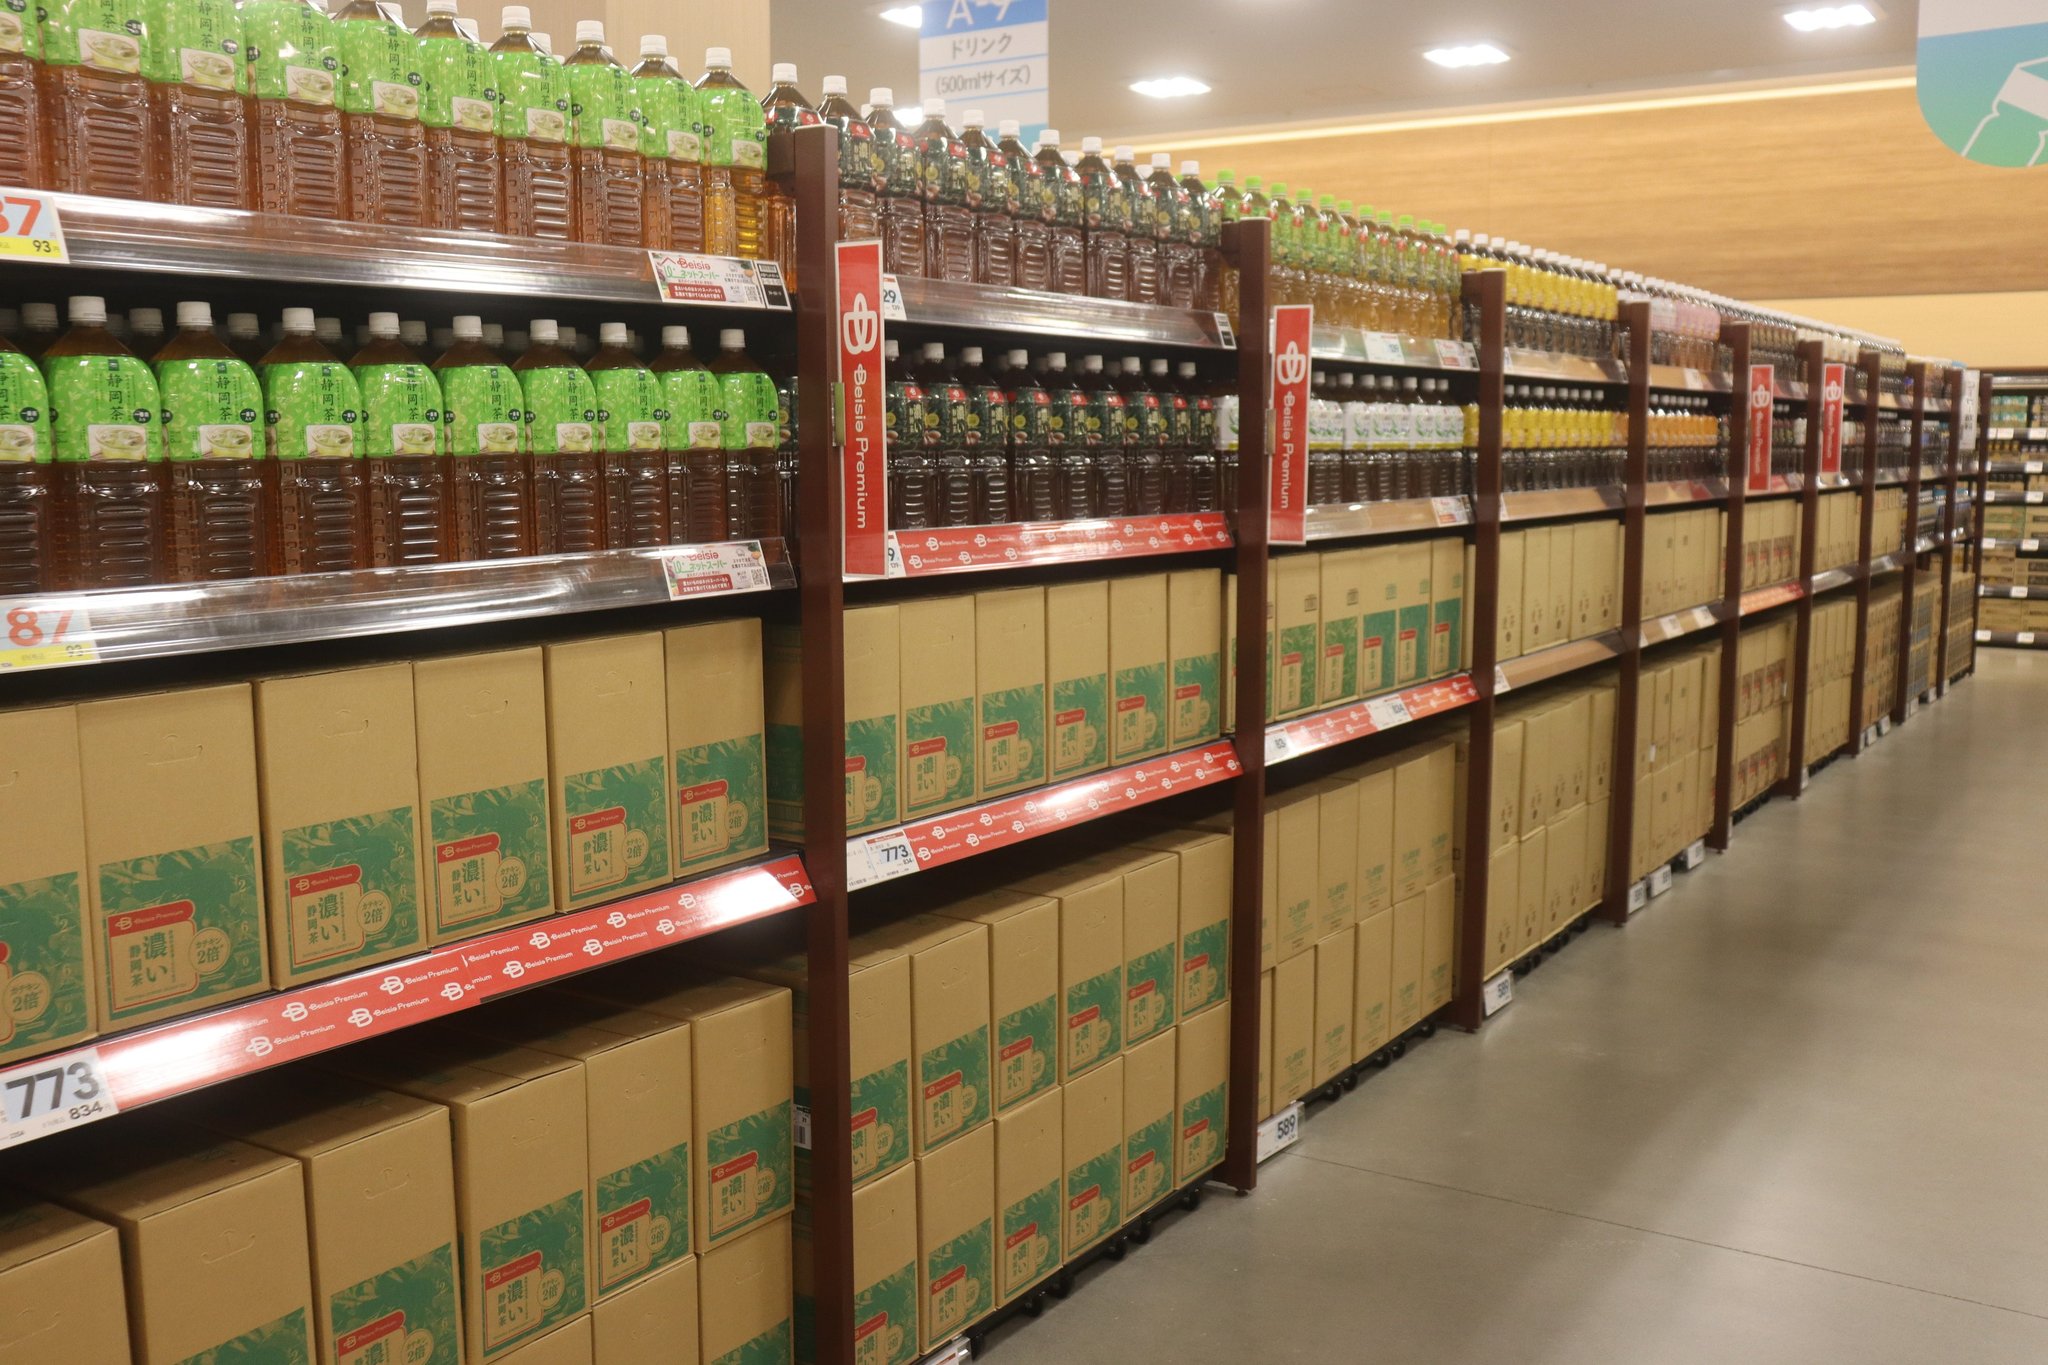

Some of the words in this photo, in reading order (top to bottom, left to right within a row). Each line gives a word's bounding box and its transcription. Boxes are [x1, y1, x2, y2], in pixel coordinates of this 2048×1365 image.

[301, 20, 316, 65] 静岡茶
[952, 33, 1012, 60] ドリンク
[388, 39, 401, 81] 静岡茶
[466, 55, 477, 95] 静岡茶
[935, 64, 1031, 95] (500mlサイズ)
[0, 196, 42, 236] 7
[33, 240, 51, 253] 93
[677, 257, 711, 270] Beisia
[106, 374, 125, 422] 静岡茶
[215, 376, 233, 422] 静岡茶
[320, 378, 335, 421] 静岡茶
[406, 379, 419, 421] 静岡茶
[490, 380, 502, 421] 静岡茶
[567, 382, 579, 420] 静岡茶
[637, 382, 648, 420] 静岡茶
[853, 363, 868, 434] Beisia
[1282, 391, 1296, 441] Beisia
[855, 436, 869, 530] Premium
[1280, 442, 1295, 510] Premium
[7, 607, 74, 647] 87
[699, 801, 713, 841] 濃い
[729, 814, 743, 829] 2倍
[592, 831, 608, 873] 濃い
[627, 845, 642, 860] 2倍
[881, 844, 909, 862] 773
[461, 859, 481, 904] 濃い
[500, 865, 520, 876] カテキン
[501, 874, 520, 889] 2倍
[451, 867, 462, 907] 静岡茶
[318, 893, 339, 940] 濃い
[361, 900, 384, 911] カテキン
[363, 908, 385, 926] 2倍
[627, 911, 645, 920] Beisia
[645, 905, 670, 916] Premium
[306, 905, 318, 945] 静岡茶
[551, 930, 571, 940] Beisia
[572, 924, 598, 936] Premium
[603, 938, 622, 947] Beisia
[622, 931, 648, 942] Premium
[142, 931, 168, 983] 濃い
[195, 937, 223, 949] カテキン
[197, 947, 221, 966] 2倍
[468, 952, 490, 963] Beisia
[490, 944, 519, 957] Premium
[128, 944, 143, 988] 静岡茶
[405, 974, 427, 985] Beisia
[428, 965, 458, 979] Premium
[525, 959, 545, 969] Beisia
[546, 951, 573, 963] Premium
[13, 992, 38, 1013] 2倍
[309, 999, 334, 1011] Beisia
[335, 991, 368, 1006] Premium
[373, 1005, 396, 1017] Beisia
[397, 996, 429, 1011] Premium
[274, 1033, 299, 1045] Beisia
[300, 1023, 335, 1038] Premium
[5, 1062, 99, 1119] 773
[69, 1100, 104, 1119] 834
[1277, 1114, 1296, 1139] 589
[729, 1175, 742, 1213] 濃い
[757, 1181, 770, 1195] 2倍
[619, 1225, 635, 1264] 濃い
[651, 1232, 664, 1247] 2倍
[507, 1281, 523, 1320] 濃い
[542, 1286, 558, 1301] 2倍
[408, 1347, 425, 1364] 2倍
